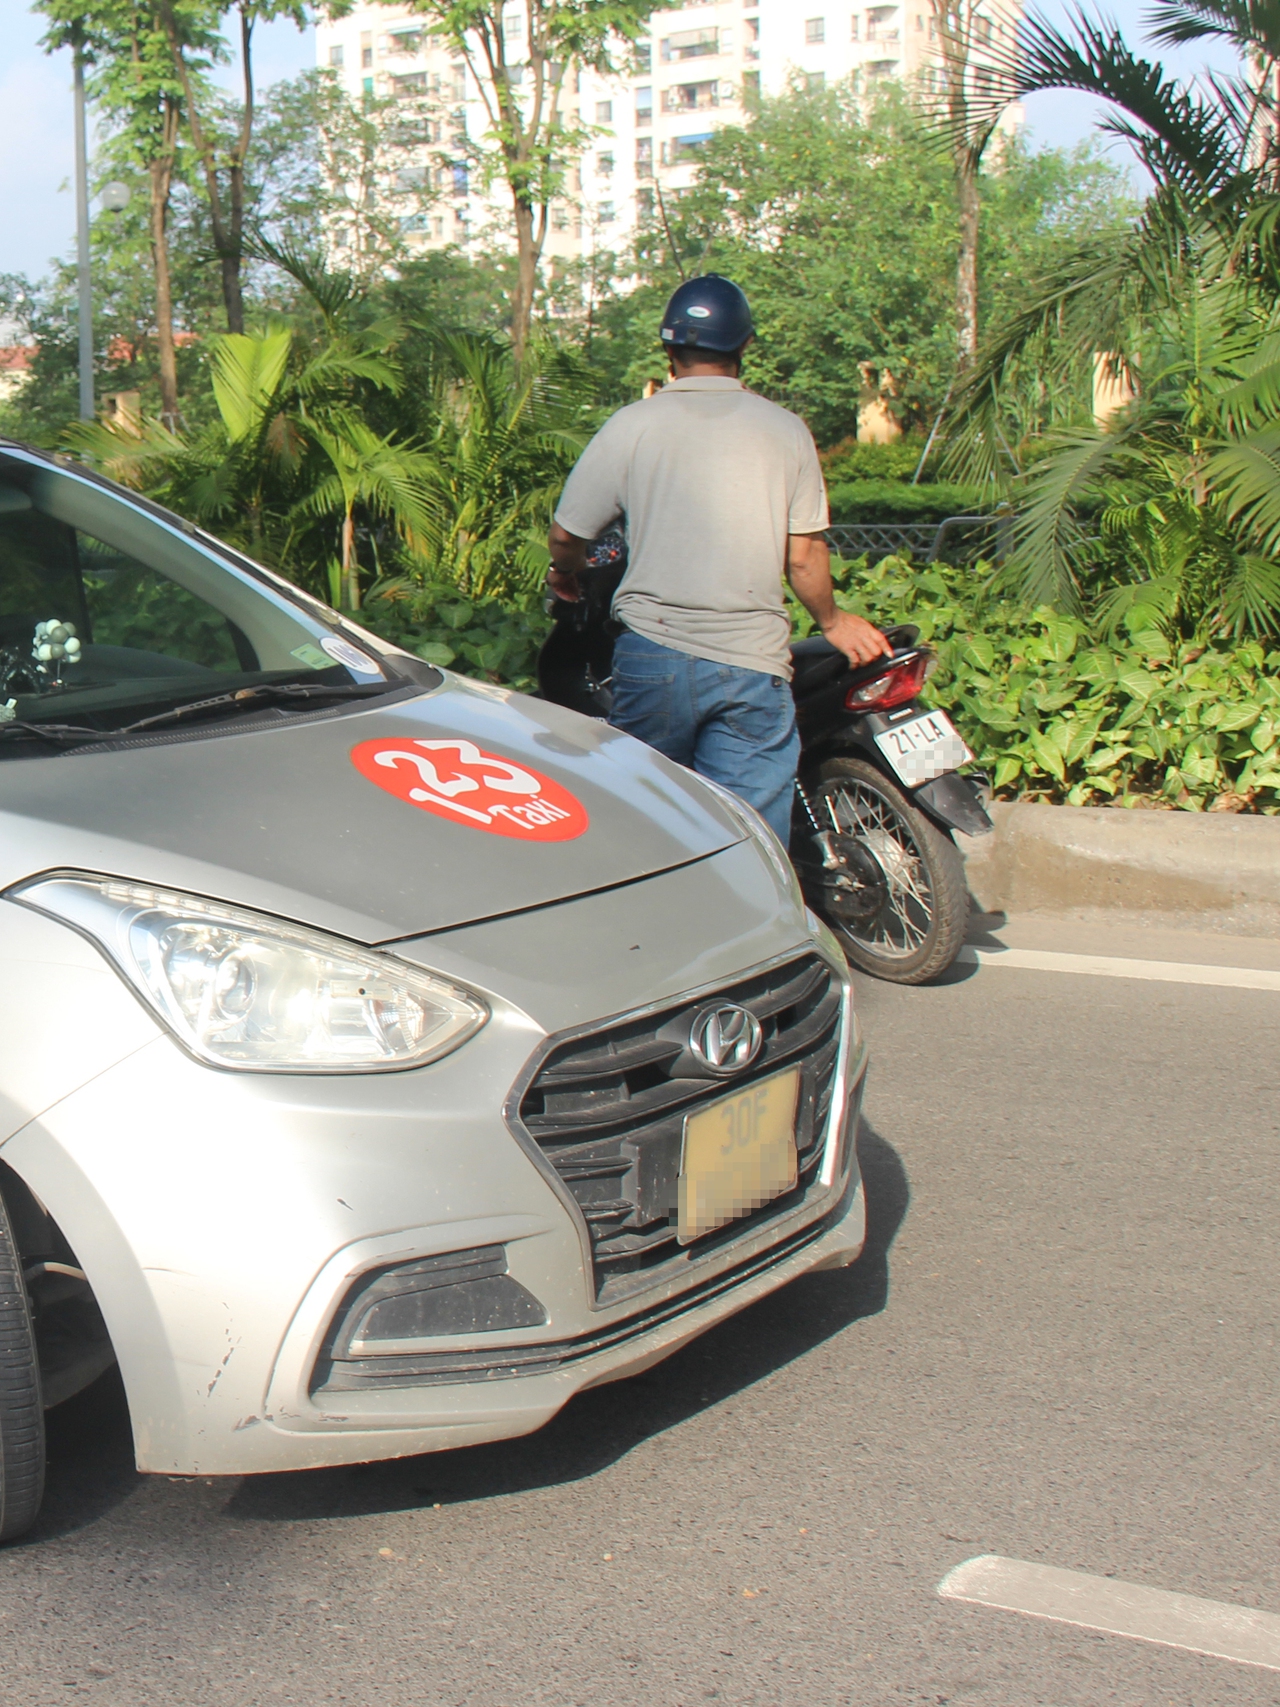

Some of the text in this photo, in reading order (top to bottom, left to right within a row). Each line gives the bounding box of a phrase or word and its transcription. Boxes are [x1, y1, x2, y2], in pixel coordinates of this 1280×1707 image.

[374, 739, 542, 825] 123
[487, 794, 571, 830] Taxi
[720, 1086, 769, 1156] 30F
